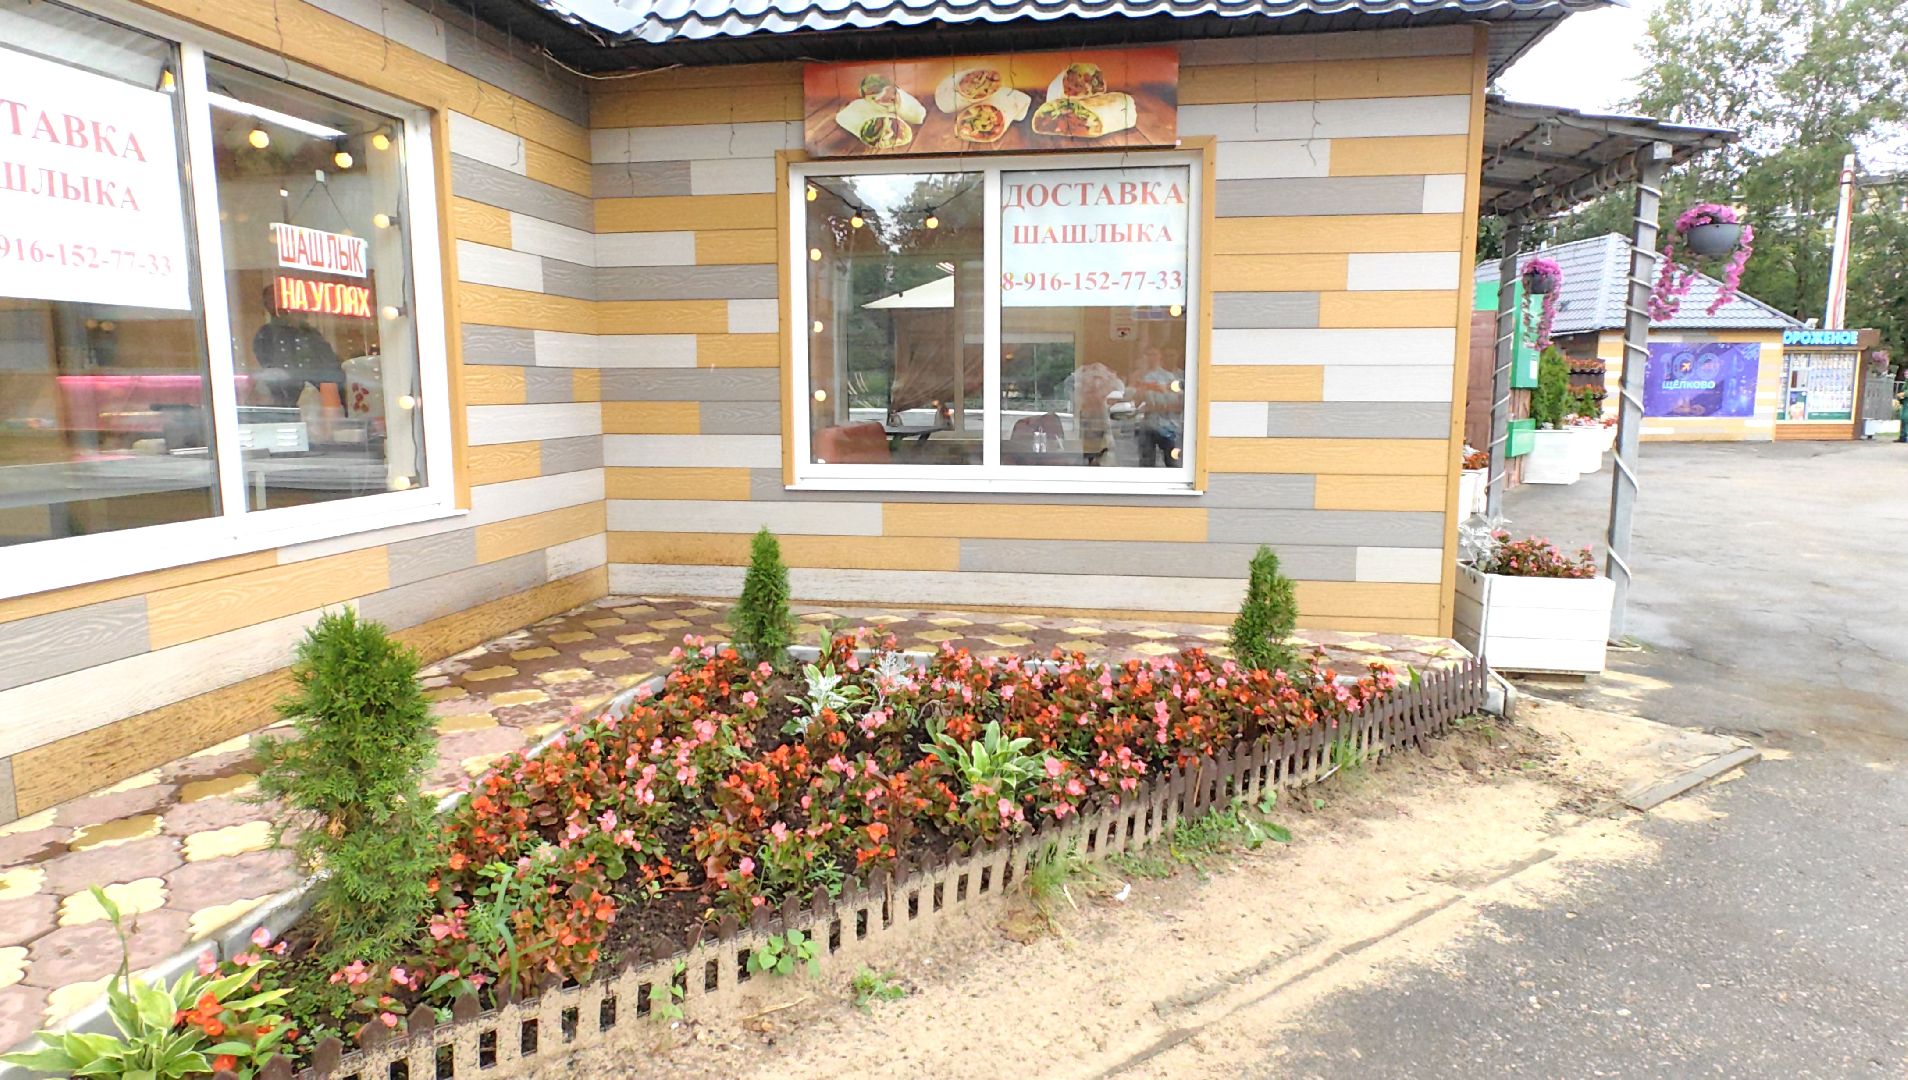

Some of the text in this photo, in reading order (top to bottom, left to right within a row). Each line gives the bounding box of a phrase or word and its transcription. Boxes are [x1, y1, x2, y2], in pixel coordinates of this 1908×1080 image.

[0, 98, 148, 163] ТАВКА
[1002, 181, 1185, 211] ДОСТАВКА
[279, 225, 364, 274] ШАШЛЫК
[1013, 223, 1173, 244] ШАШЛЫКА
[280, 276, 371, 317] НА УГЛЯХ
[1002, 270, 1183, 291] 8-916-152-77-33
